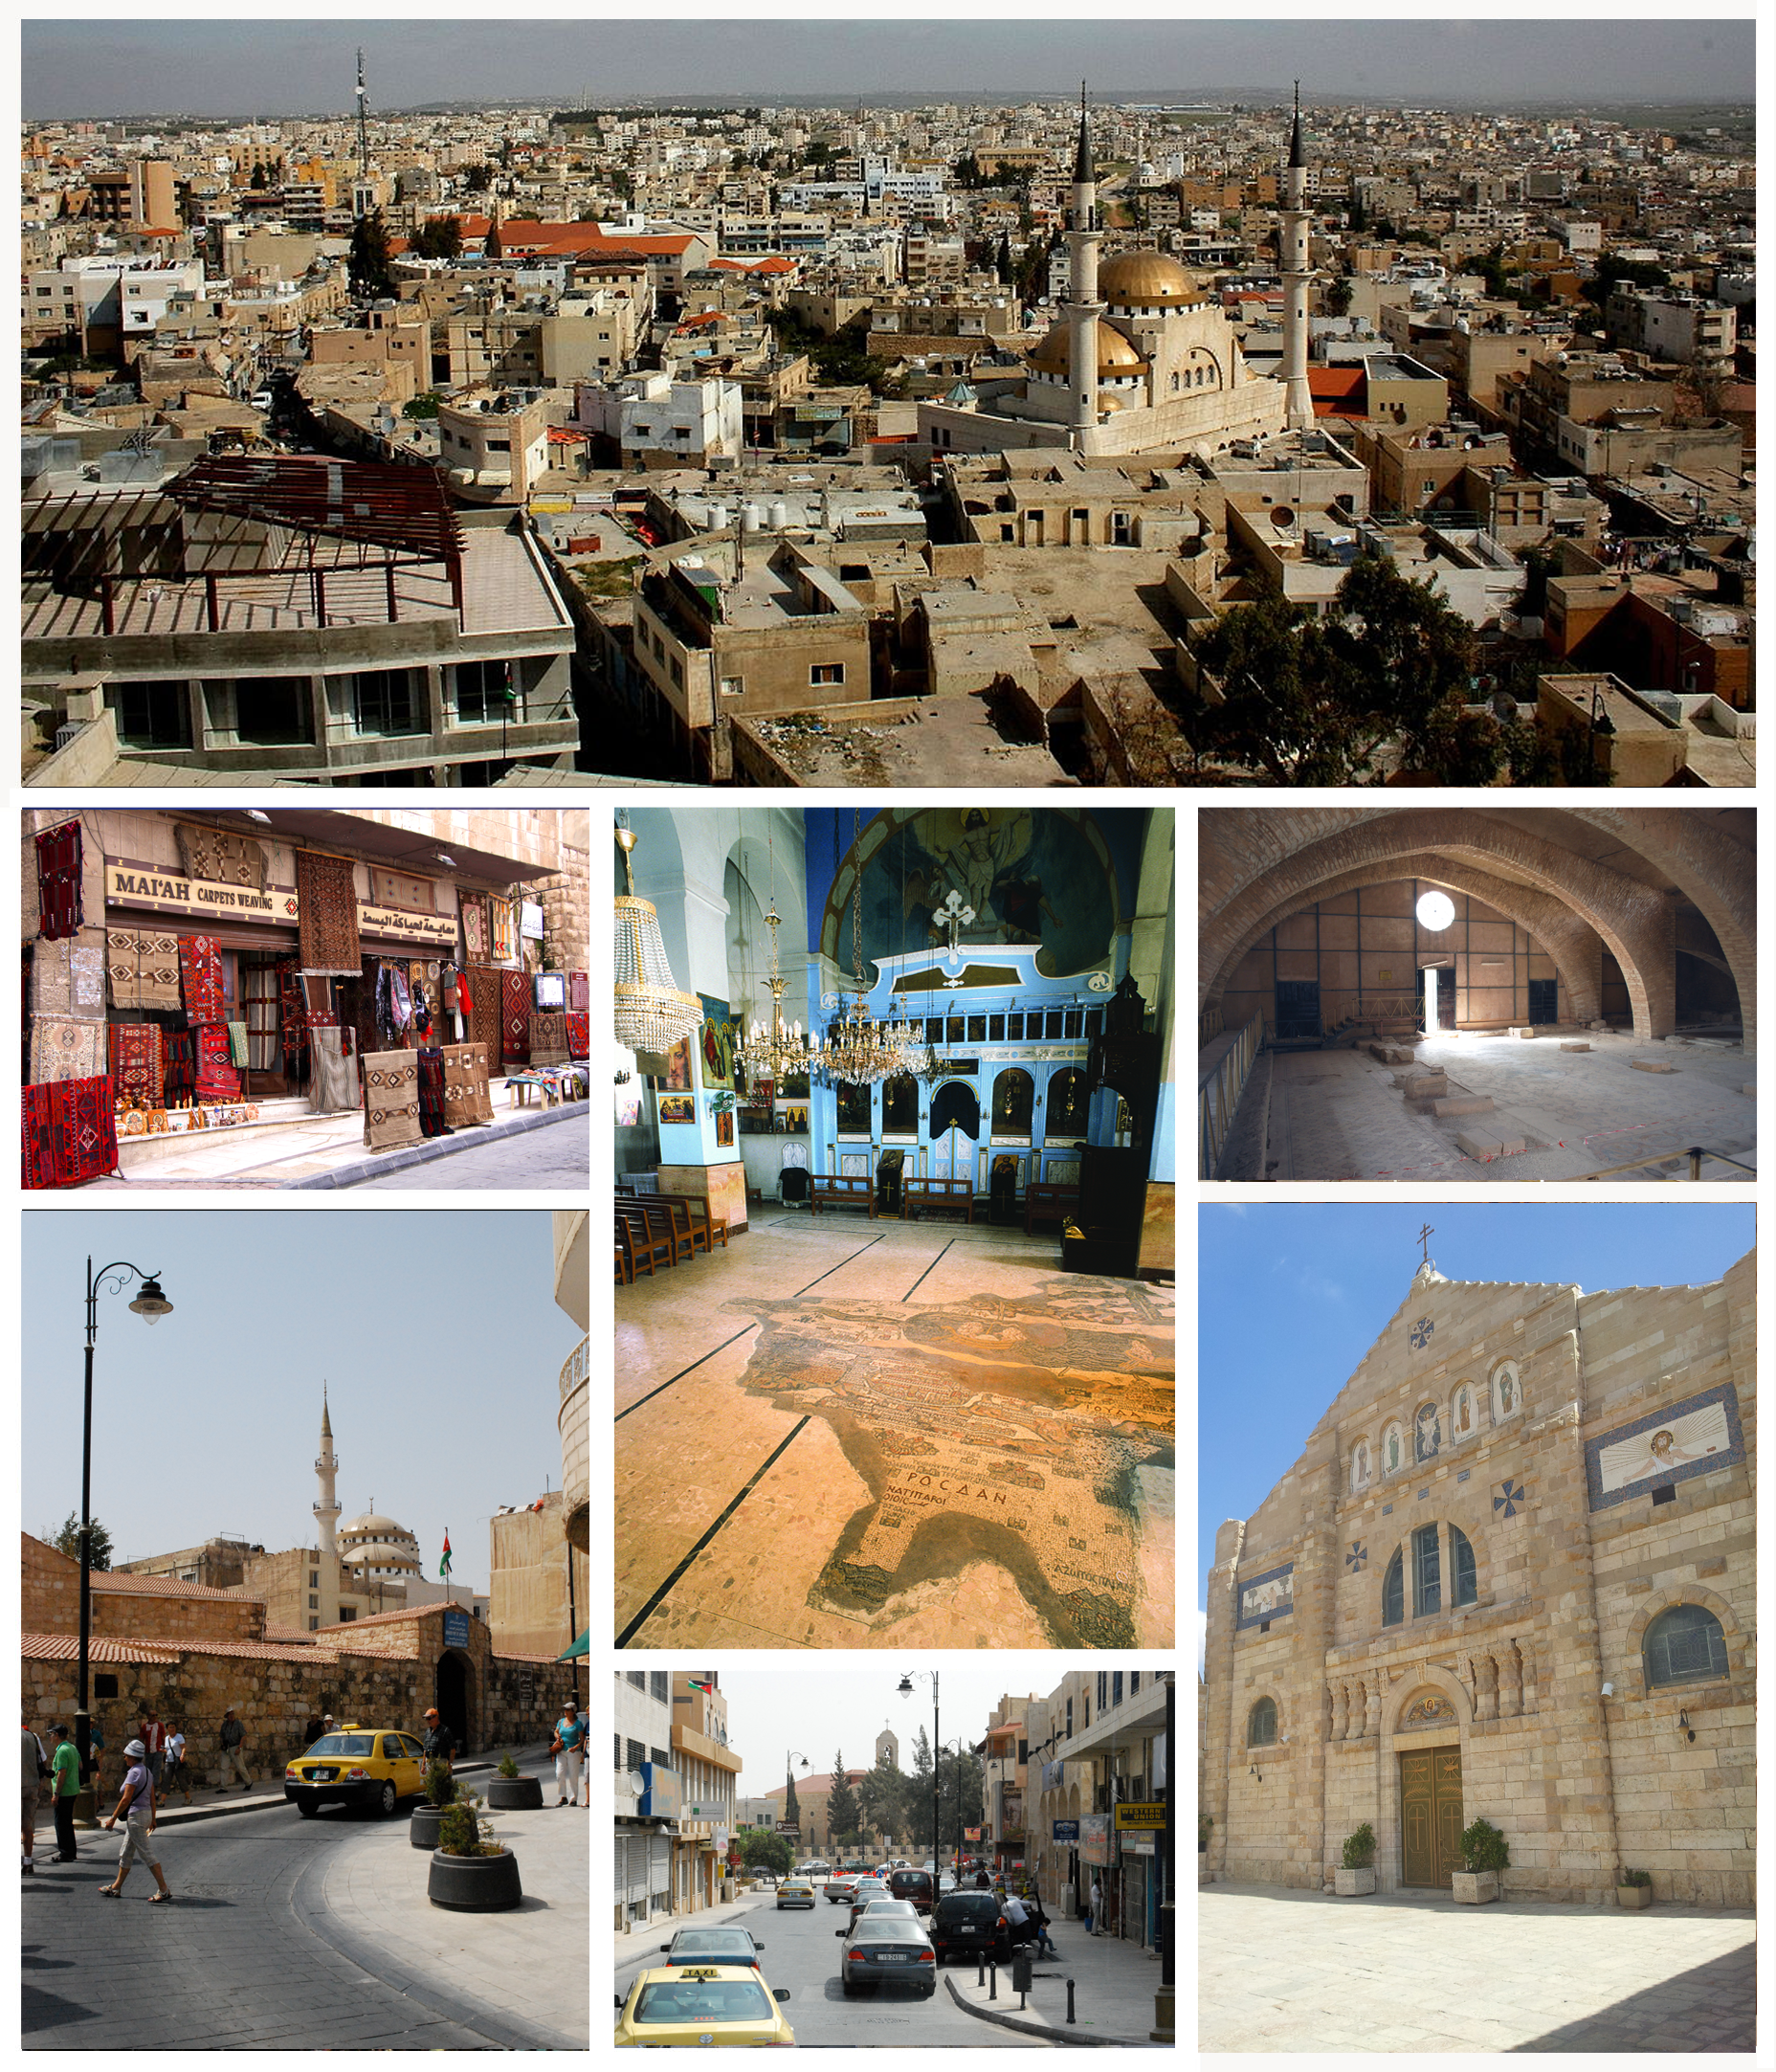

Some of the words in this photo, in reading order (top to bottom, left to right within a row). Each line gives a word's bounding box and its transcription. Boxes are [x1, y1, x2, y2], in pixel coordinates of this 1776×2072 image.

[197, 888, 235, 905] CARPETS
[237, 894, 273, 910] WEAVING
[362, 911, 392, 929] البسط
[392, 914, 423, 934] لحياكة
